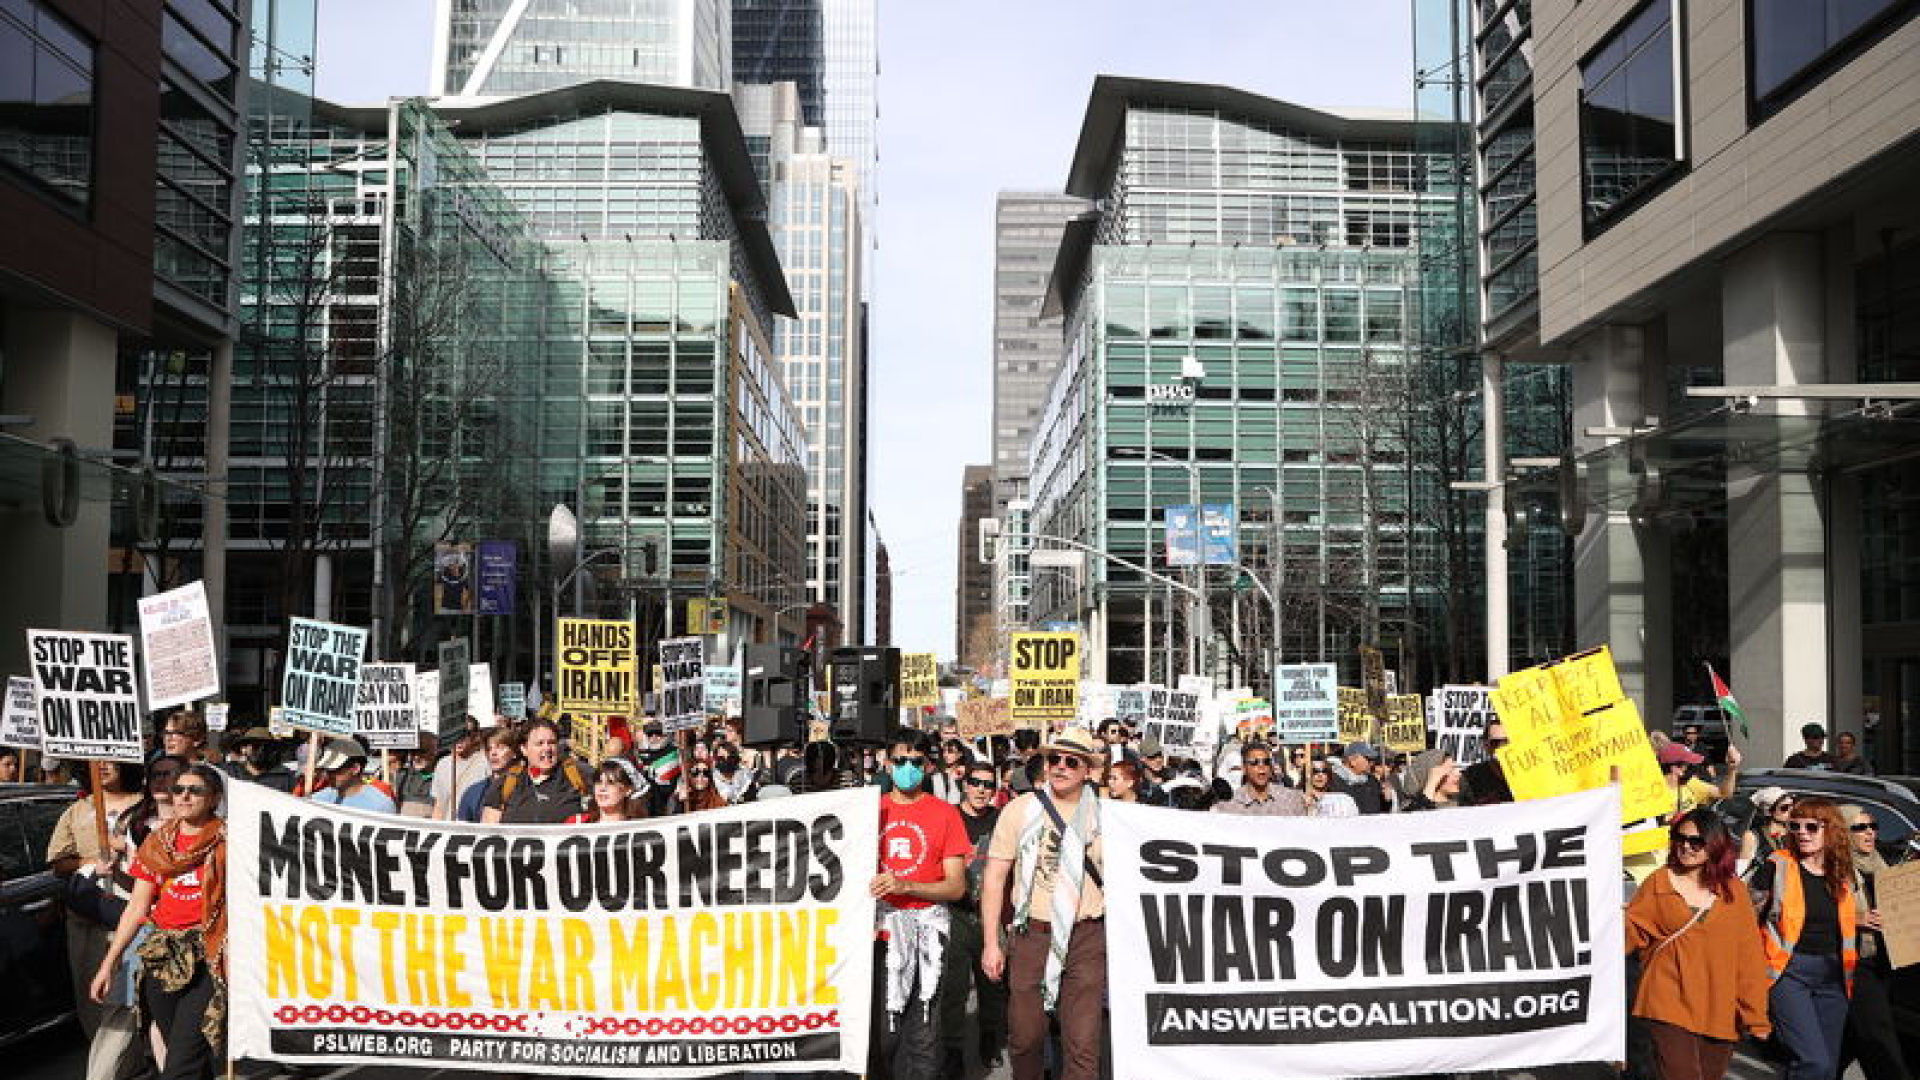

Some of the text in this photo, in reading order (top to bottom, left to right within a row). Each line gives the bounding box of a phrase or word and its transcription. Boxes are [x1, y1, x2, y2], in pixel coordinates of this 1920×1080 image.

[293, 624, 361, 656] STOP THE
[563, 623, 630, 649] HANDS
[34, 636, 130, 667] STOP THE
[293, 648, 358, 679] WAR
[563, 648, 631, 668] OFF
[662, 643, 681, 663] STOP
[1016, 638, 1075, 670] STOP
[37, 665, 133, 694] WAR
[361, 667, 406, 683] WOMEN
[563, 669, 630, 701] IRAN!
[663, 662, 702, 682] WAR
[1015, 679, 1042, 687] THE
[286, 672, 356, 718] ON IRAN!
[358, 683, 385, 704] SAY
[389, 683, 409, 704] NO
[1015, 689, 1073, 706] ON IRAN
[1150, 690, 1198, 709] NO NEW
[1445, 691, 1479, 709] STOP
[42, 696, 139, 742] ON IRAN!
[355, 710, 373, 730] TO
[377, 710, 415, 730] WAR!
[1552, 726, 1644, 777] NETANYAHU
[259, 811, 442, 907] MONEY
[444, 834, 548, 912] FOR
[556, 830, 667, 912] OUR
[676, 814, 844, 907] NEEDS
[1139, 825, 1587, 888] STOP THE
[1140, 878, 1591, 984] WAR ON IRAN!
[263, 902, 840, 1012] NOT THE WAR MACHINE
[1161, 990, 1580, 1032] ANSWERCOALITION.ORG
[314, 1033, 796, 1063] PSLWEB.ORG PARTY FOR SOCIALISM AND LIBERATION
